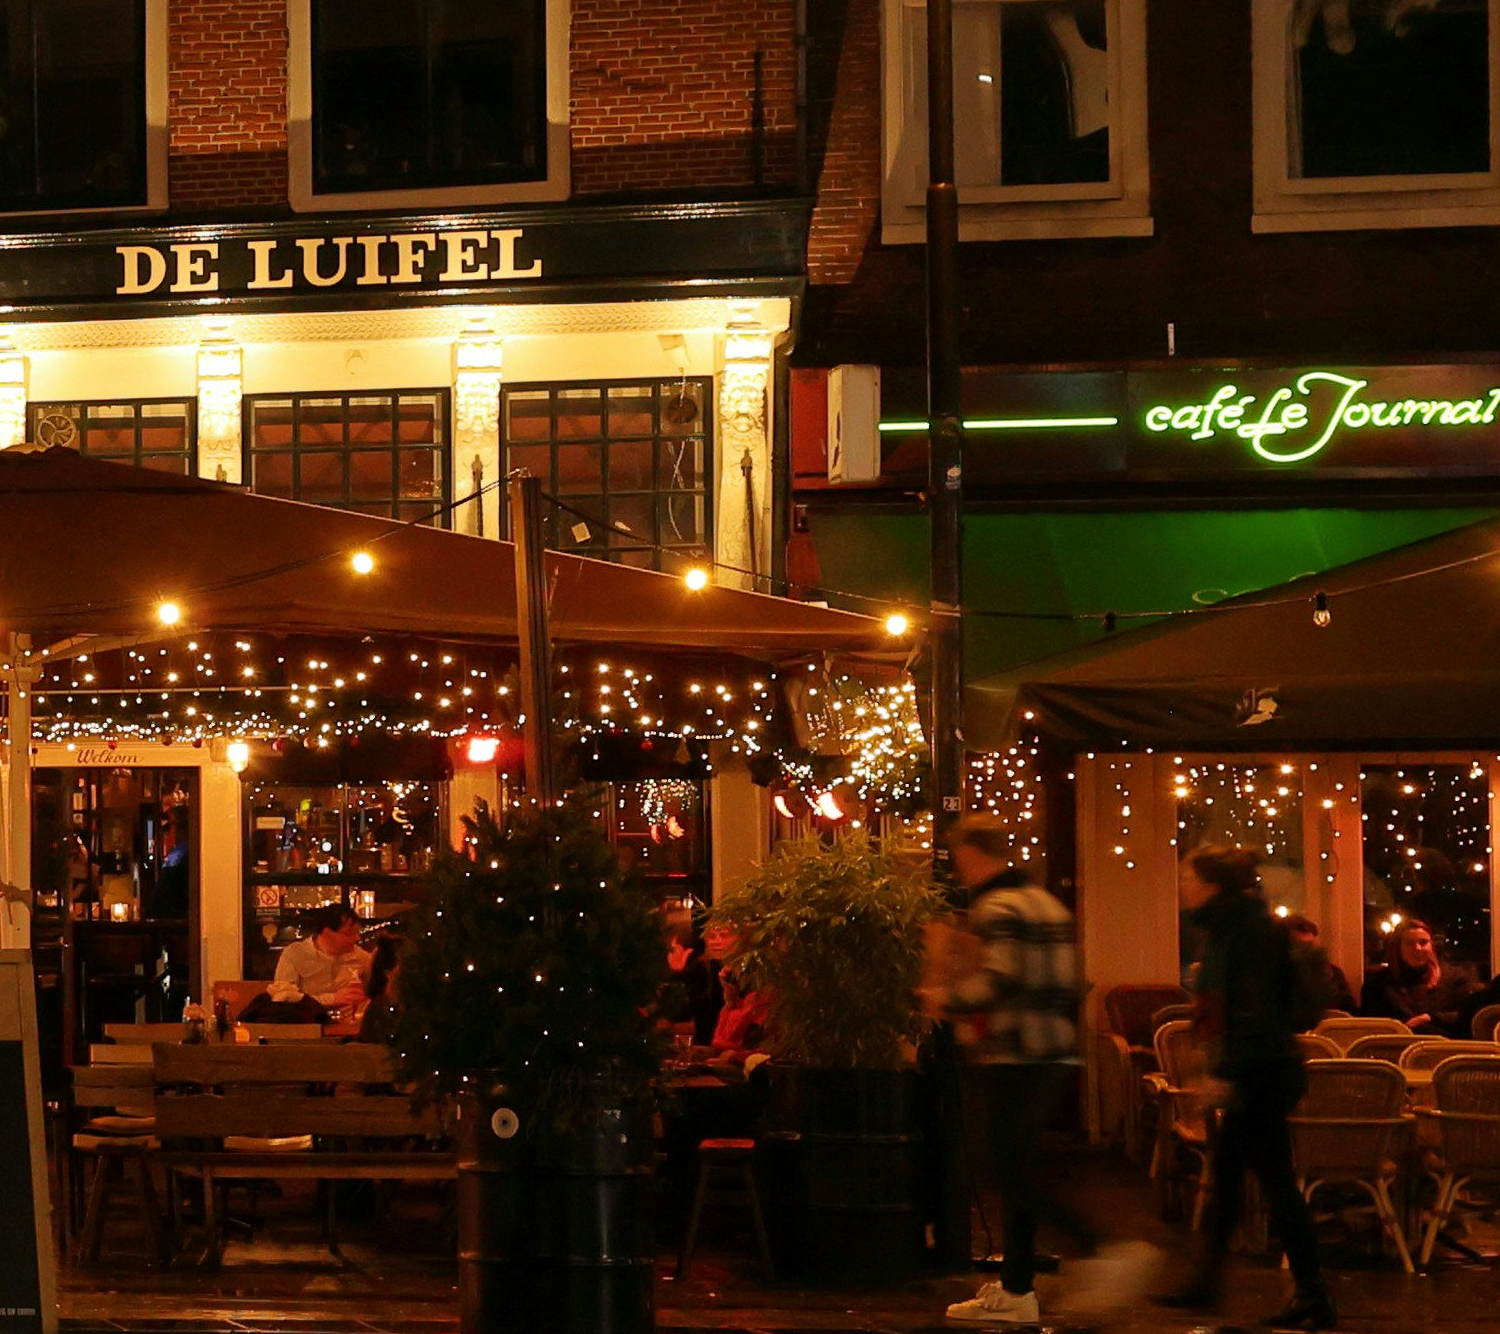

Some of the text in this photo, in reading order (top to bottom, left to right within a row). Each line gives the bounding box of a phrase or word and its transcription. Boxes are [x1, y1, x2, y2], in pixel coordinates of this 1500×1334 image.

[115, 228, 542, 295] DE LUIFEL
[1145, 371, 1500, 463] café Le Journal
[76, 748, 141, 765] Welkom
